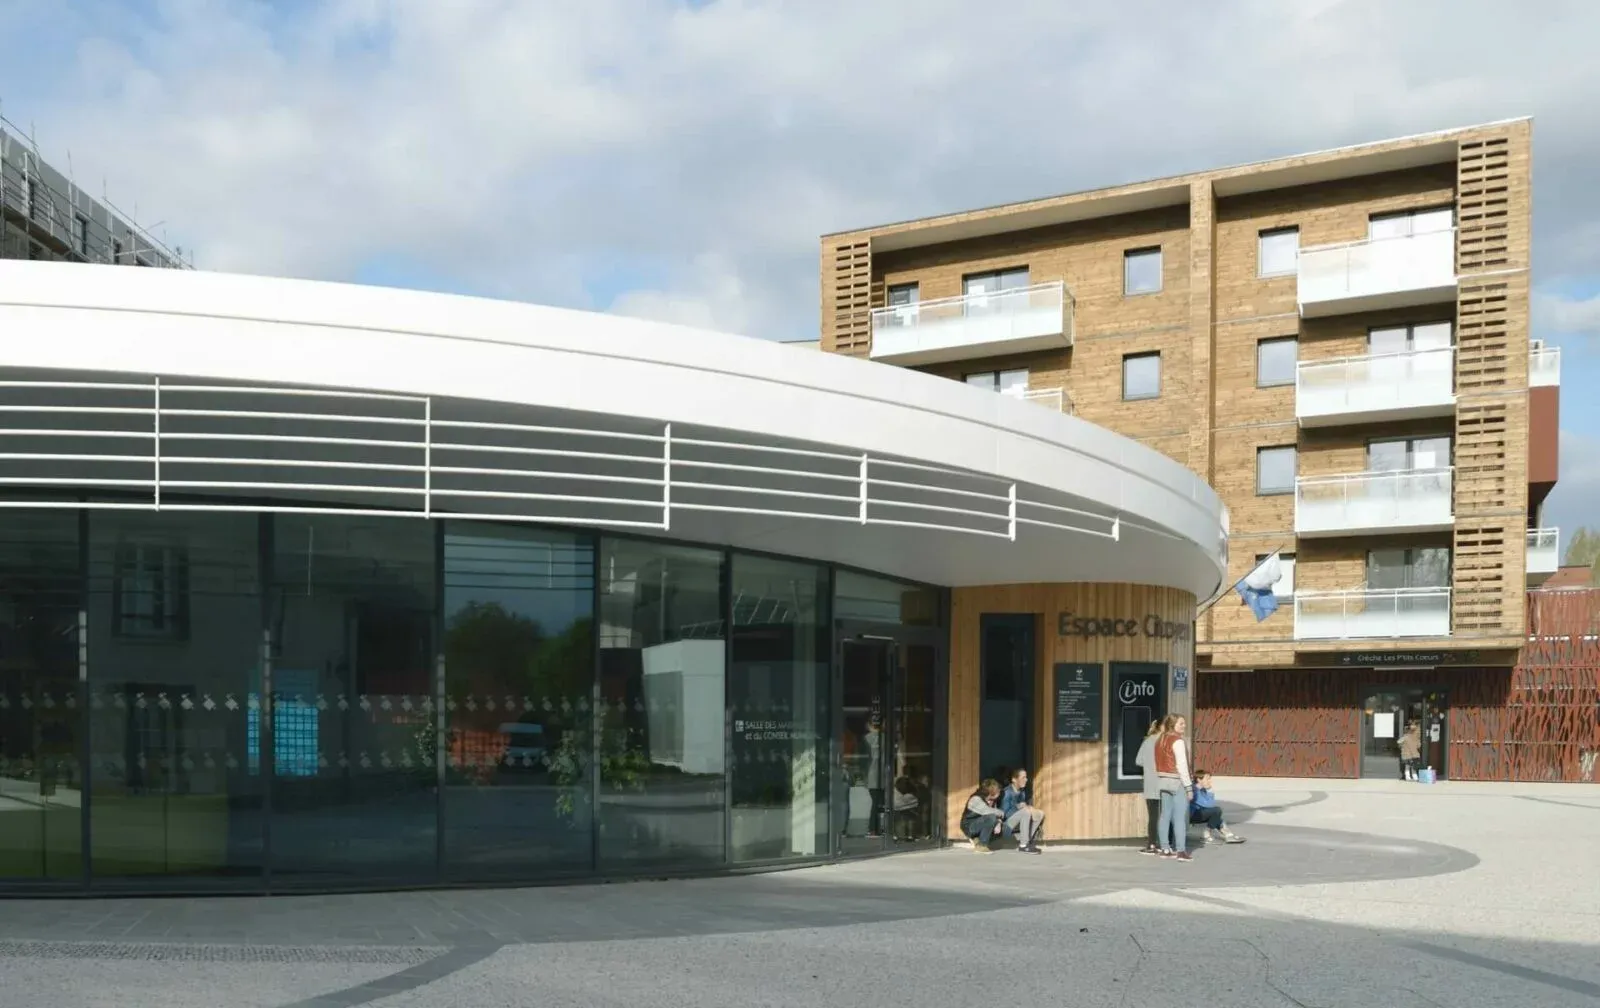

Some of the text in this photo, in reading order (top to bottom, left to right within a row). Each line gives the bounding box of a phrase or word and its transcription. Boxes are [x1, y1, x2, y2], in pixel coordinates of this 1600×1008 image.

[1058, 612, 1138, 641] Espace
[1120, 680, 1155, 702] info
[744, 720, 763, 730] SALLE
[764, 720, 777, 729] DES
